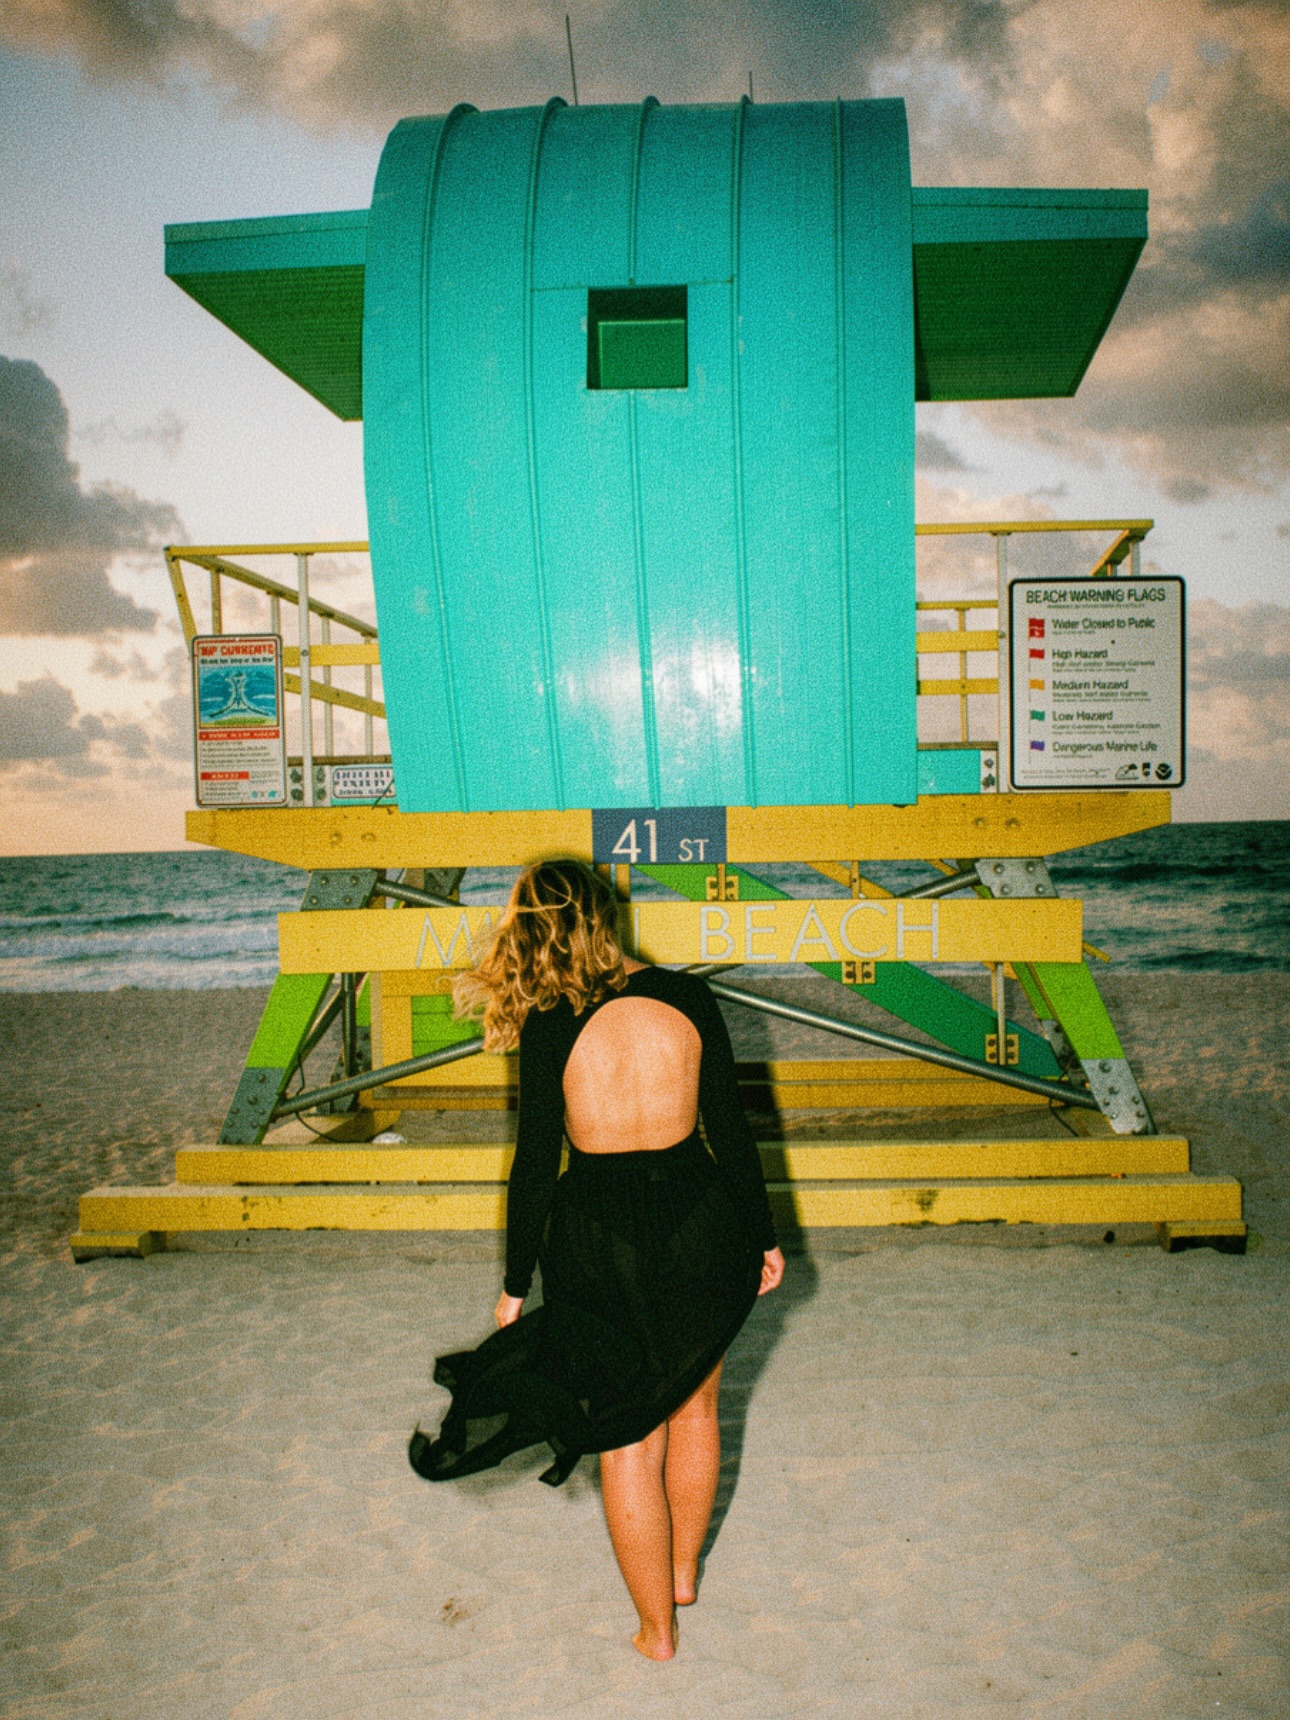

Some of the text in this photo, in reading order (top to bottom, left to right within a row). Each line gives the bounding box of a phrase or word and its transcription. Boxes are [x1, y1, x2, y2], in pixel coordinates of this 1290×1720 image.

[1026, 588, 1166, 603] BEACH WARNING FLAGS
[1117, 618, 1127, 629] to
[1074, 649, 1108, 660] Hazard
[1052, 679, 1129, 690] Medium Hazard
[1052, 710, 1113, 721] Low Hazard
[1052, 741, 1157, 754] Dangerous Marine Life
[612, 819, 709, 863] 41 ST
[700, 902, 939, 961] BEACH
